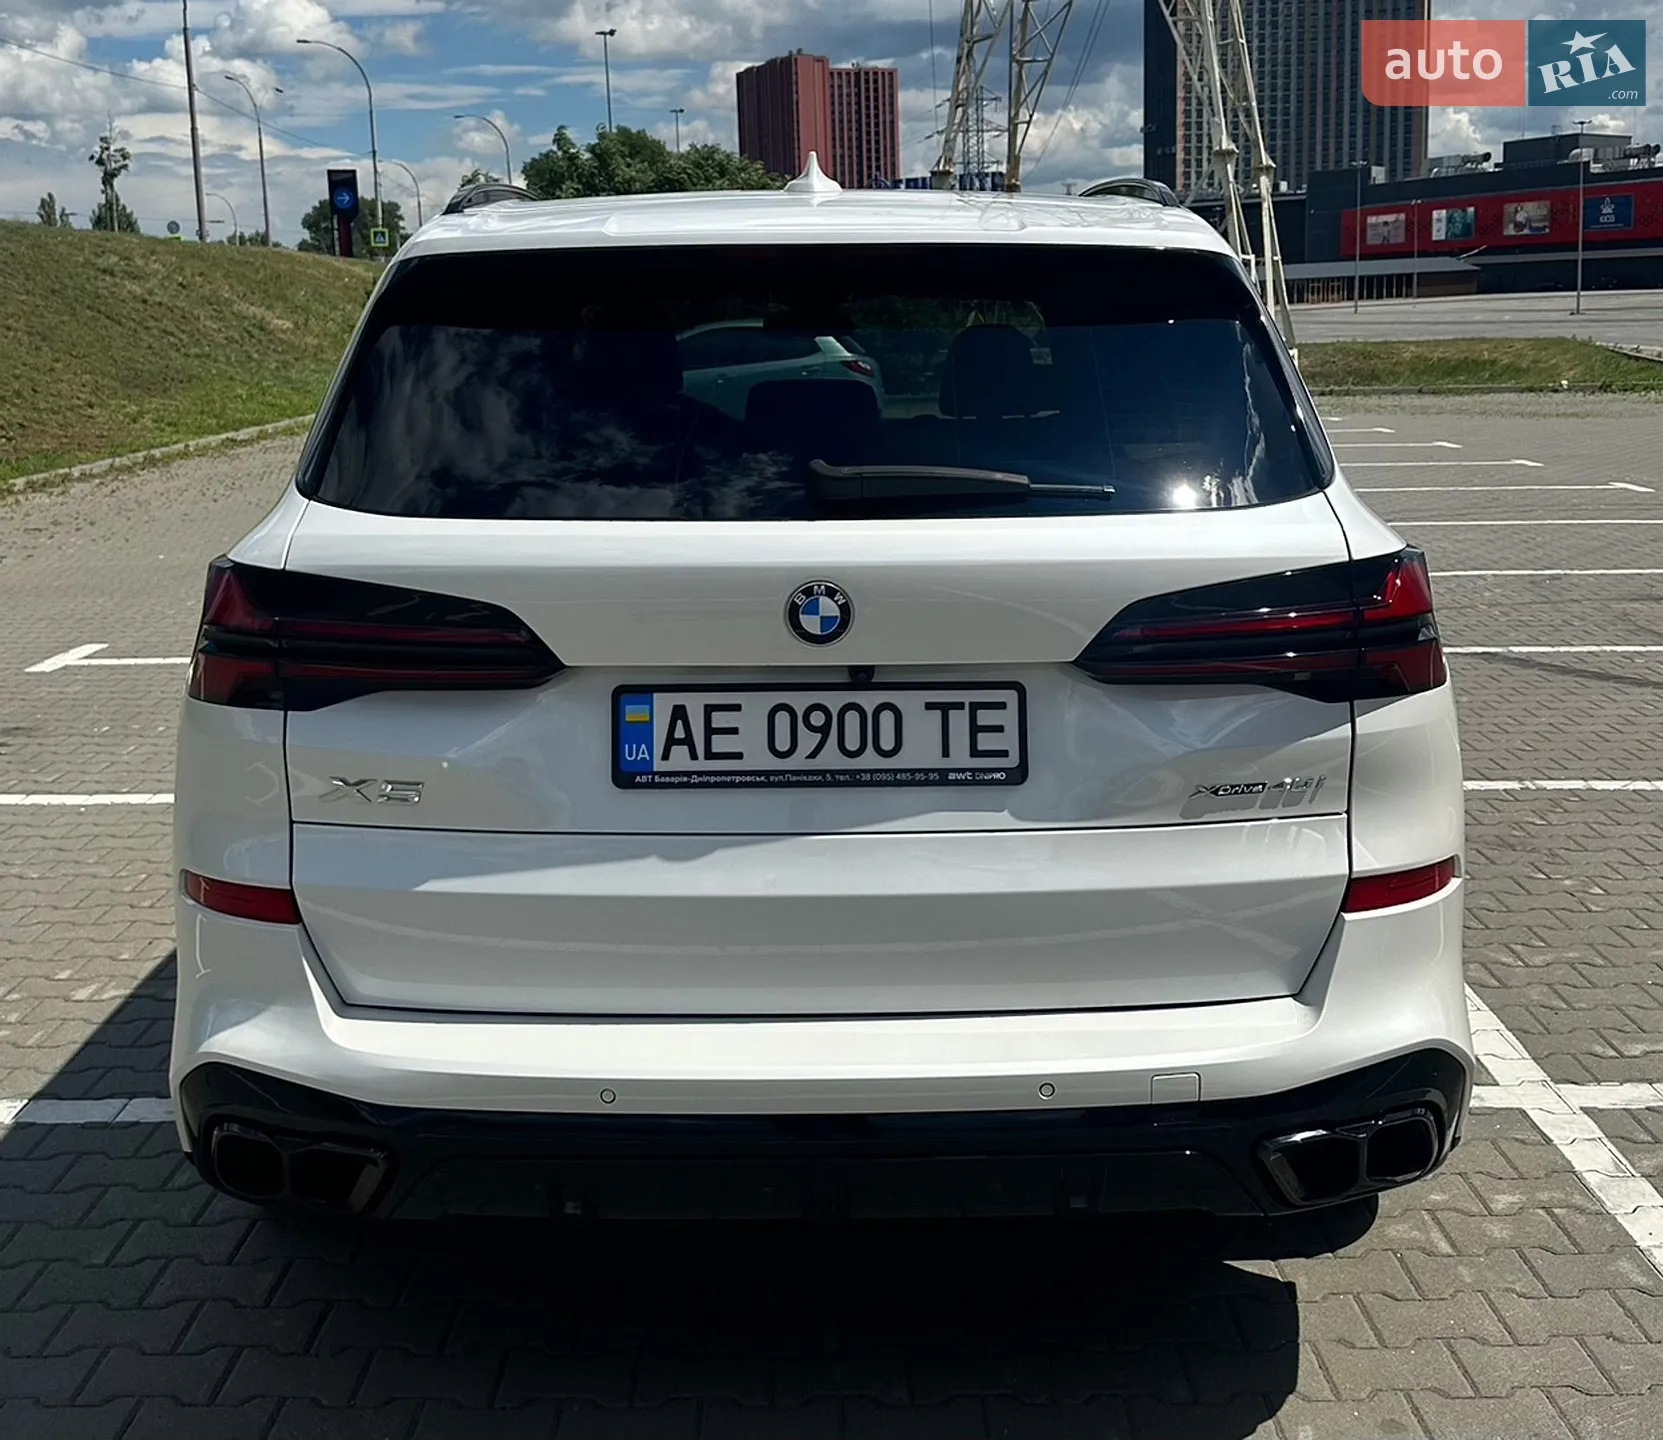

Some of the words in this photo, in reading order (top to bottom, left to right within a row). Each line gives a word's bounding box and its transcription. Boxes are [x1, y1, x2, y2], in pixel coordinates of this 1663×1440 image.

[794, 585, 846, 605] BMW
[661, 703, 743, 761] AE
[767, 702, 902, 759] 0900
[925, 701, 1009, 758] TE
[625, 744, 650, 761] UA
[319, 776, 424, 805] X5
